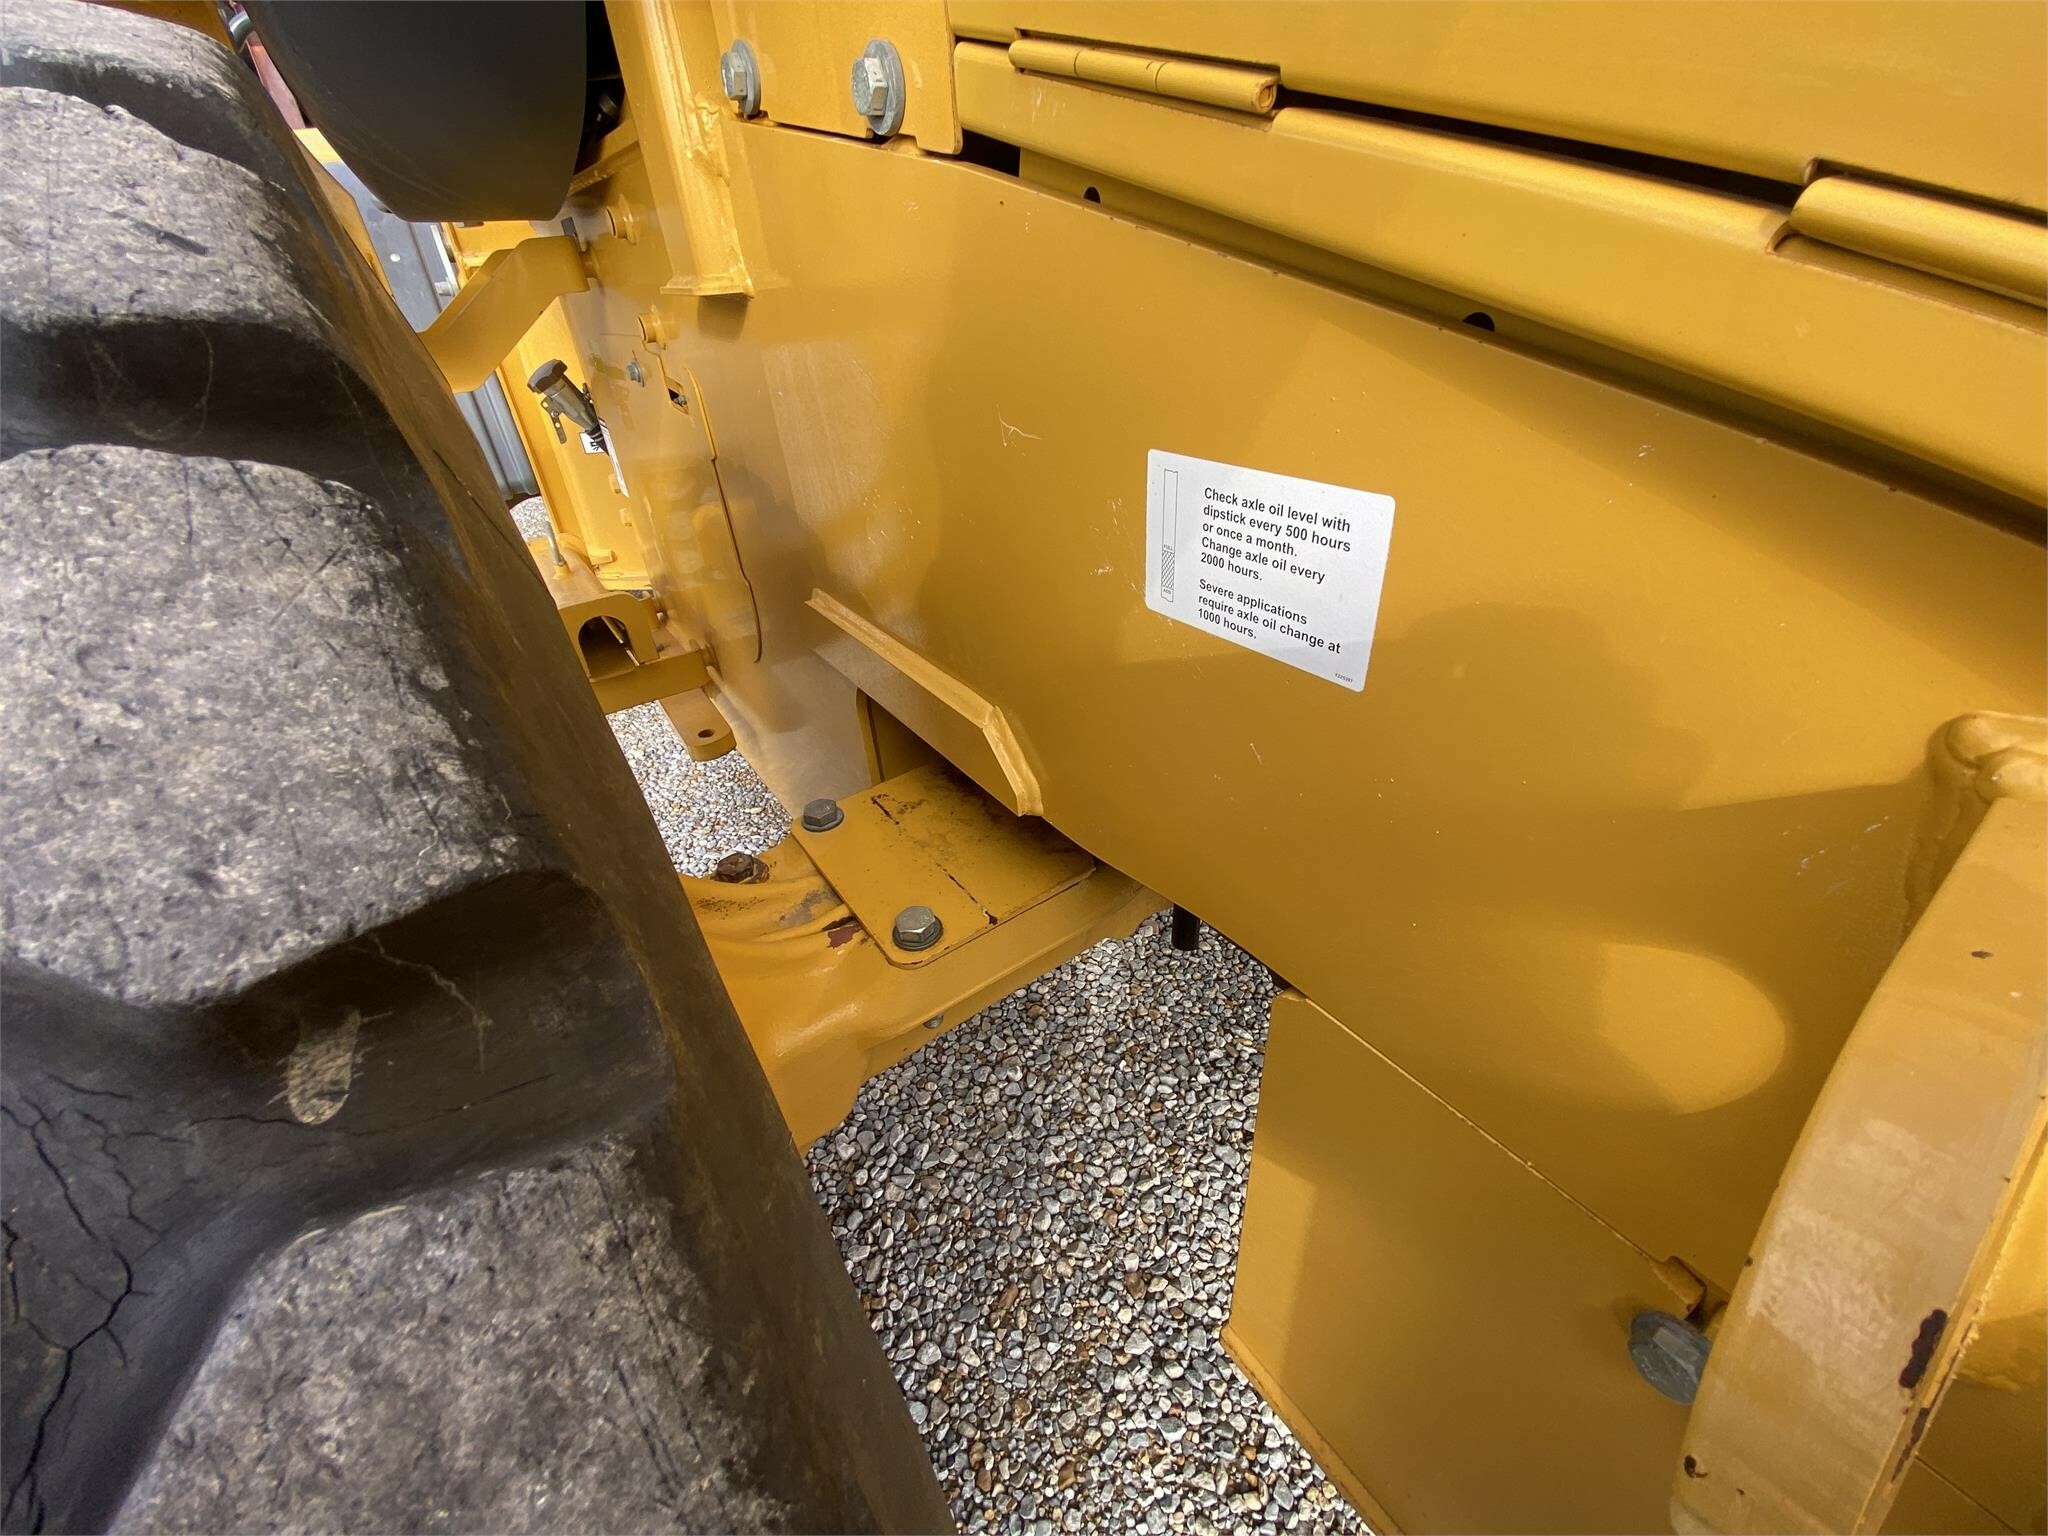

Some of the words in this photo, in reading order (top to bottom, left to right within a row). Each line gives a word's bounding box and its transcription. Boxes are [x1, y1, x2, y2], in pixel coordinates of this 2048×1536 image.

[1203, 504, 1246, 525] dipstick
[1249, 518, 1282, 536] every
[1285, 525, 1308, 541] 500
[1312, 532, 1351, 552] hours
[1204, 487, 1238, 506] Check
[1241, 497, 1265, 512] axle
[1269, 503, 1284, 516] oil
[1287, 507, 1318, 525] level
[1322, 515, 1351, 533] with
[1201, 537, 1242, 559] Change
[1245, 551, 1269, 566] axle
[1272, 558, 1287, 571] oil
[1290, 566, 1325, 584] every
[1202, 522, 1214, 532] or
[1216, 525, 1243, 542] once
[1246, 534, 1252, 544] a
[1256, 538, 1298, 557] month.
[1200, 552, 1225, 569] 2000
[1227, 560, 1263, 581] hours.
[1198, 607, 1221, 625] 1000
[1223, 616, 1257, 639] hours.
[1198, 595, 1234, 615] require
[1236, 607, 1259, 624] axle
[1262, 617, 1276, 630] oil
[1279, 624, 1325, 648] change
[1328, 641, 1341, 654] at
[1199, 578, 1234, 600] Severe
[1236, 592, 1307, 625] applications
